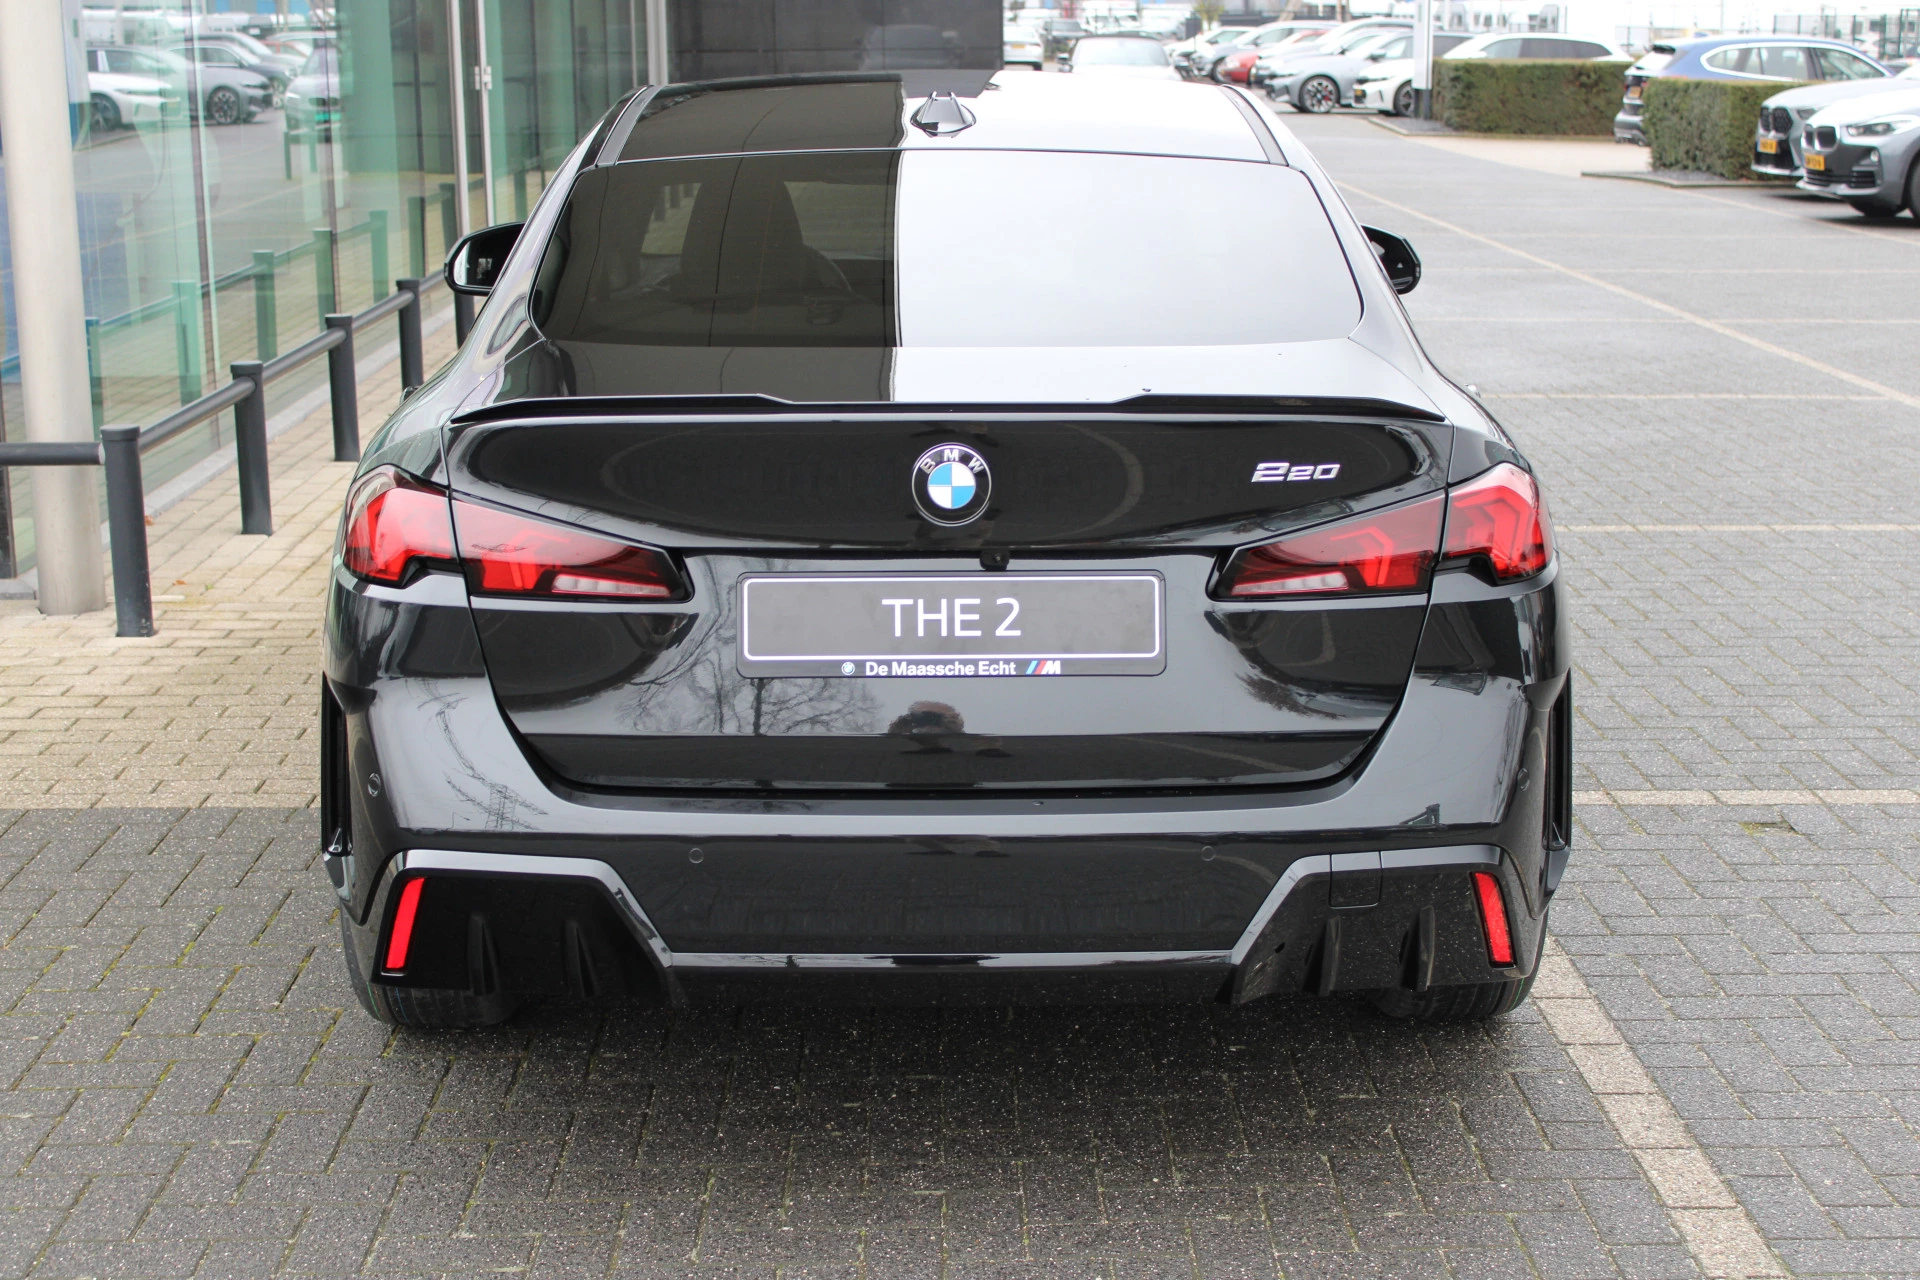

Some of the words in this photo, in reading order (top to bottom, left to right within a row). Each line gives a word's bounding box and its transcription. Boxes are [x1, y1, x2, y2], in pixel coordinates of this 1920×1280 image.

[920, 449, 984, 474] BMW
[1251, 462, 1341, 482] 220
[881, 598, 982, 637] THE
[995, 597, 1022, 637] 2
[865, 661, 888, 676] De
[891, 661, 975, 676] Maassche
[978, 660, 1016, 676] Echt
[1040, 660, 1061, 675] M
